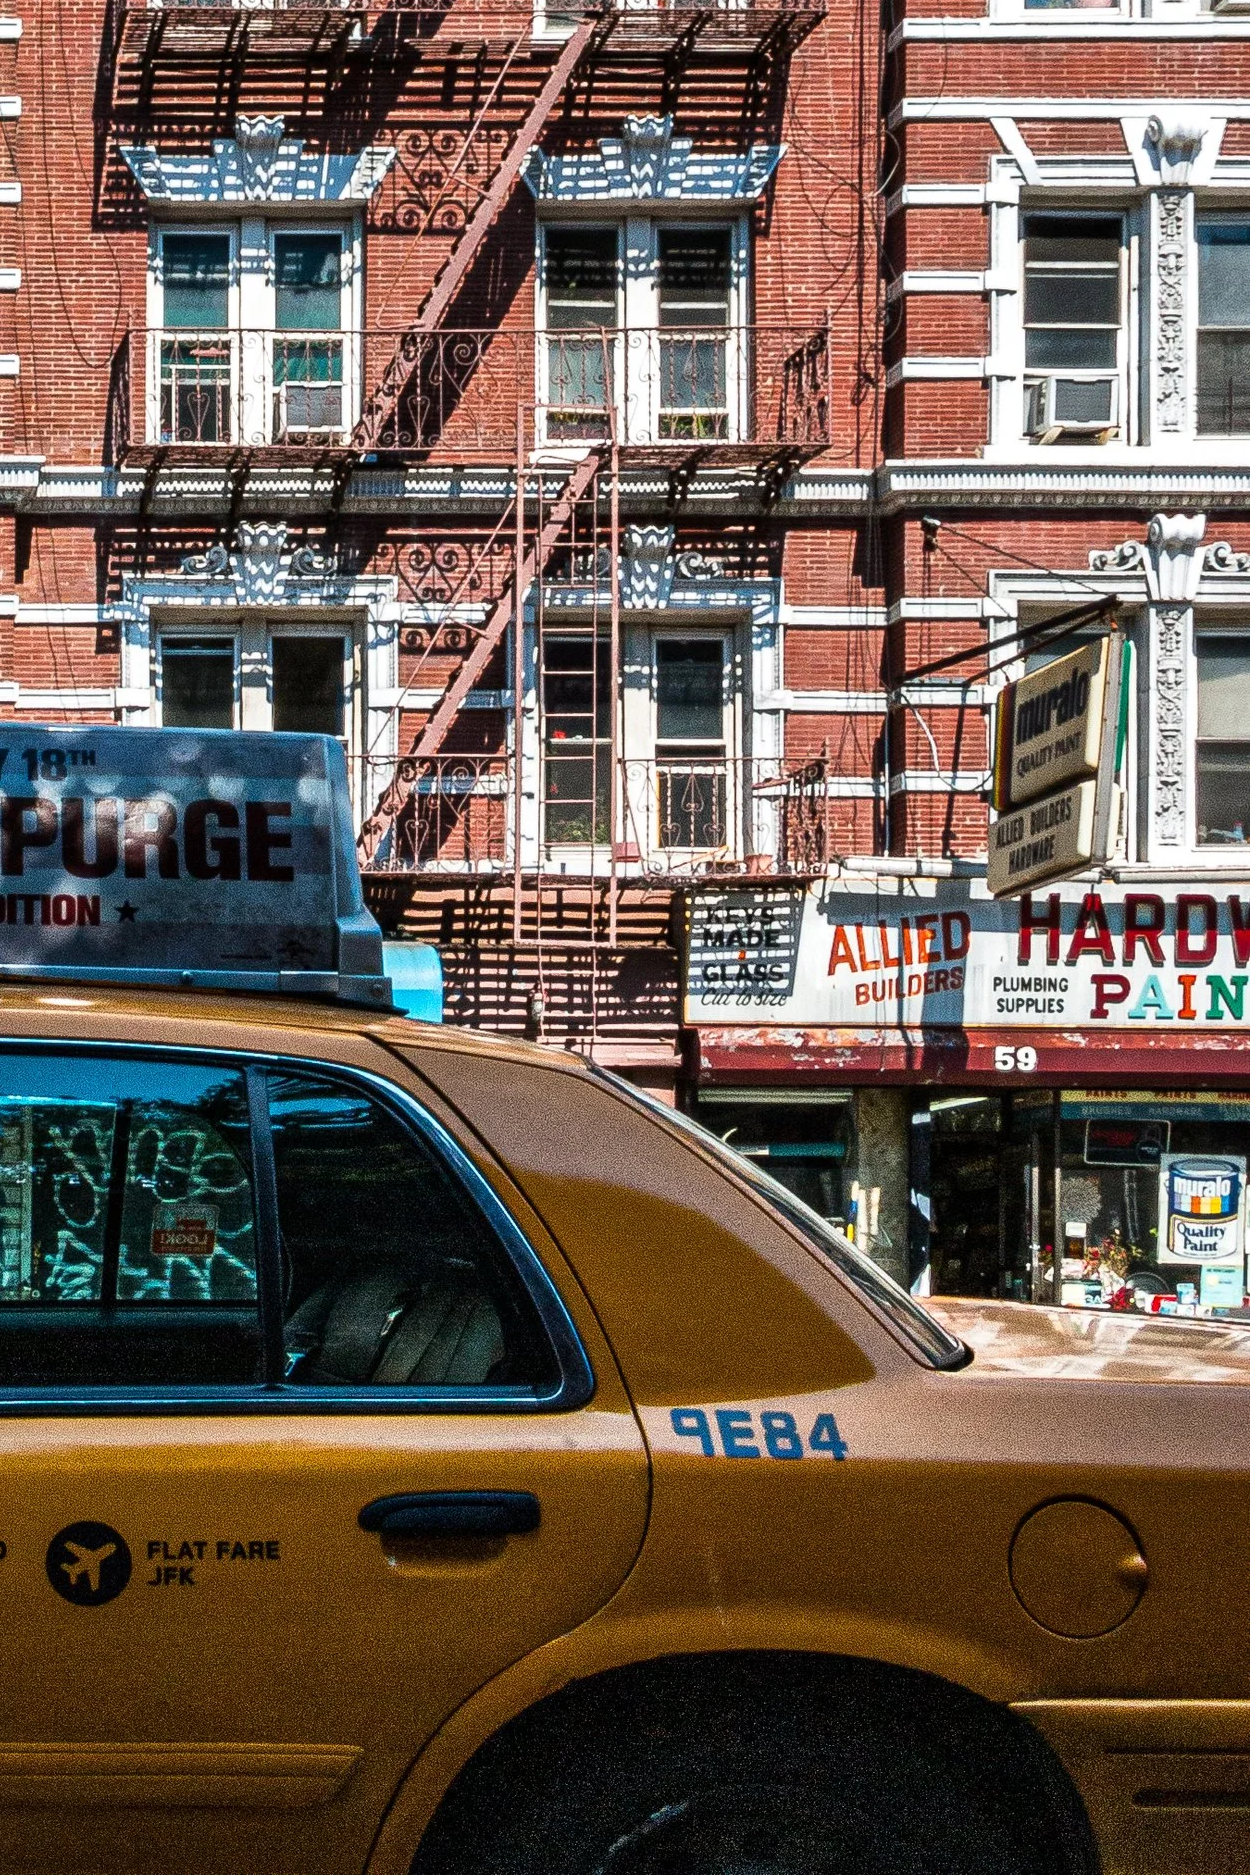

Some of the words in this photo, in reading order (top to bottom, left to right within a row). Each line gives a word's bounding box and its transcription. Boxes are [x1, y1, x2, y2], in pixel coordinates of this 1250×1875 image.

[1016, 668, 1089, 743] muralo
[21, 749, 96, 782] 18TH
[1018, 745, 1052, 778] QUALITY
[1053, 732, 1082, 758] PAINT
[996, 817, 1025, 849] ALLIED
[1029, 795, 1073, 835] BUILDERS
[2, 795, 295, 882] PURGE
[1007, 834, 1055, 875] HARDWARE
[706, 906, 775, 925] KEYS
[702, 929, 781, 949] MADE
[827, 910, 972, 977] ALLIED
[702, 963, 785, 984] GLASS
[992, 976, 1069, 993] PLUMBING
[700, 986, 732, 1007] Cut
[736, 987, 753, 1007] to
[754, 987, 789, 1008] size
[854, 966, 965, 1007] BUILDERS
[996, 997, 1065, 1014] SUPPLIES
[993, 1045, 1038, 1072] 59
[1173, 1176, 1232, 1198] muralo
[1177, 1222, 1227, 1241] Quality
[1183, 1238, 1219, 1253] Paint
[670, 1407, 849, 1462] 9E84
[147, 1540, 208, 1561] FLAT
[215, 1540, 281, 1561] FARE
[148, 1566, 196, 1587] JFK
